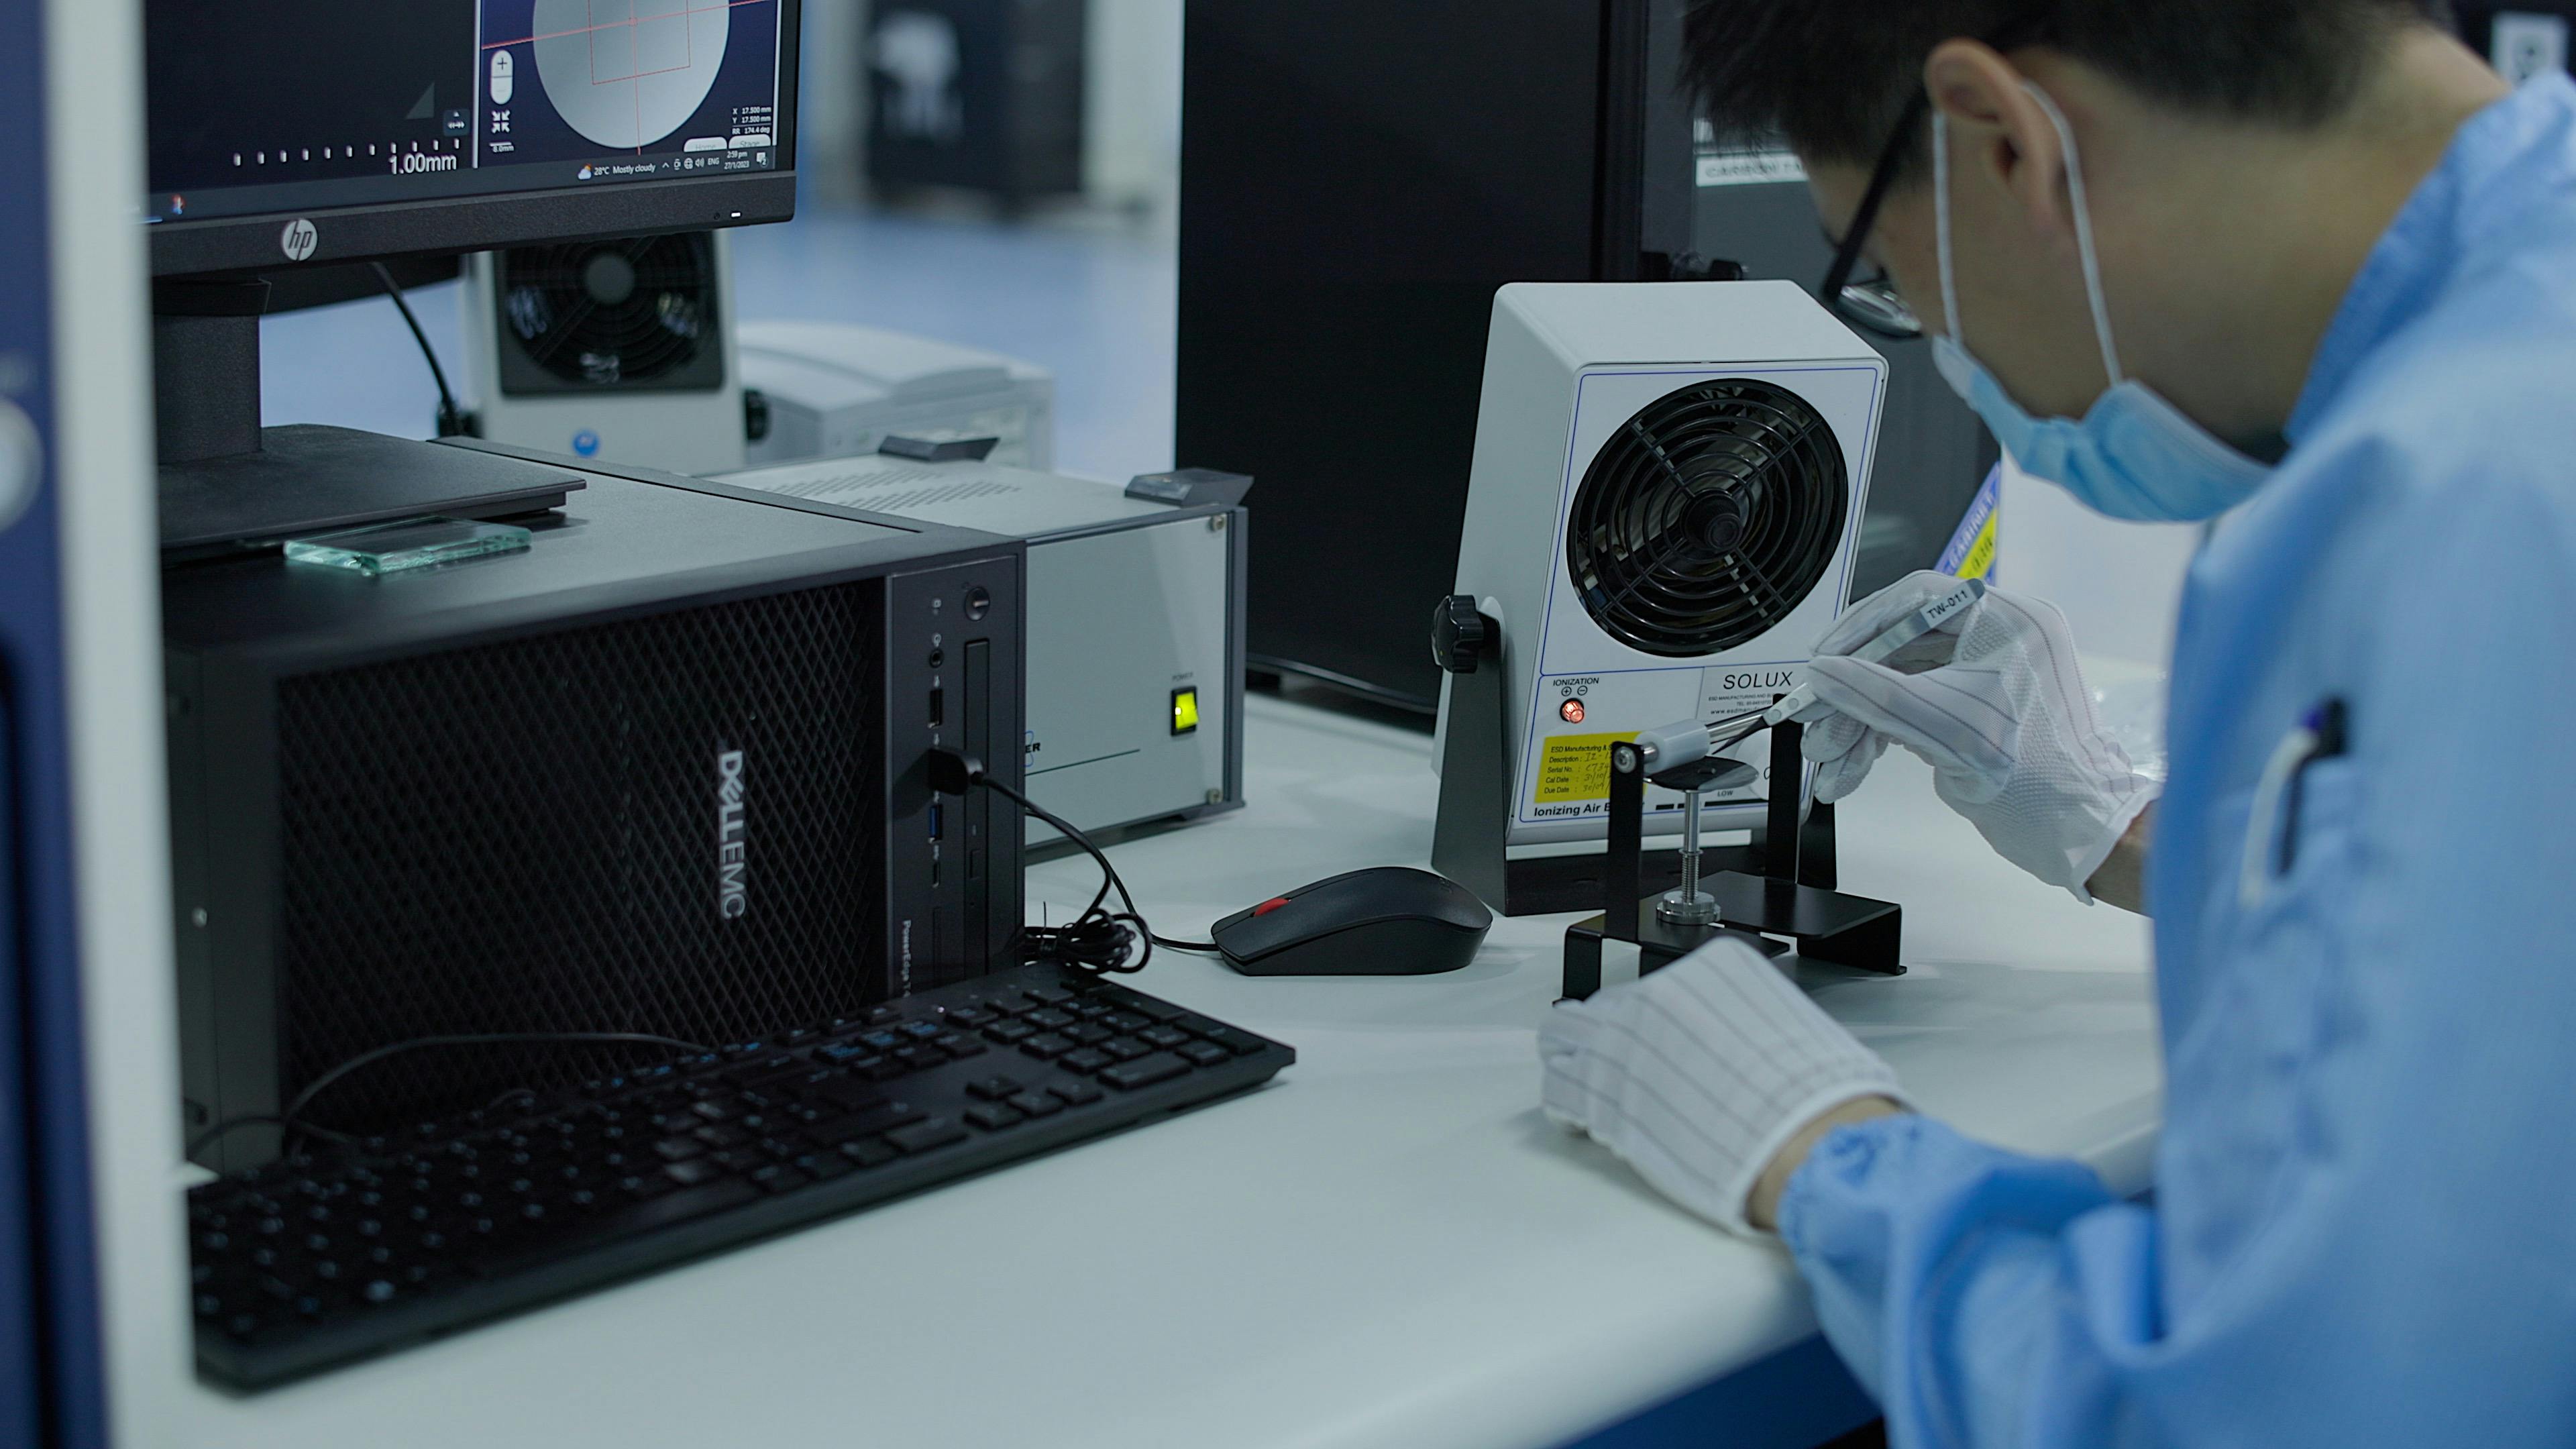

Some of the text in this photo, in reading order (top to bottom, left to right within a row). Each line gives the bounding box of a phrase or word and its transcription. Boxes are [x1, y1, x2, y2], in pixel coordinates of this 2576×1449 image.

[738, 151, 747, 159] pm
[388, 152, 457, 174] 1.00mm
[612, 165, 634, 175] Mostly
[635, 162, 656, 173] cloudy
[288, 220, 314, 261] hp
[1927, 590, 1968, 619] TW-011
[1172, 672, 1193, 681] POWER
[1553, 678, 1599, 686] IONIZATION
[1723, 672, 1793, 690] SOLUX
[1564, 745, 1602, 753] Manufacturing
[1534, 806, 1580, 816] Ionizing
[1583, 804, 1601, 813] Air
